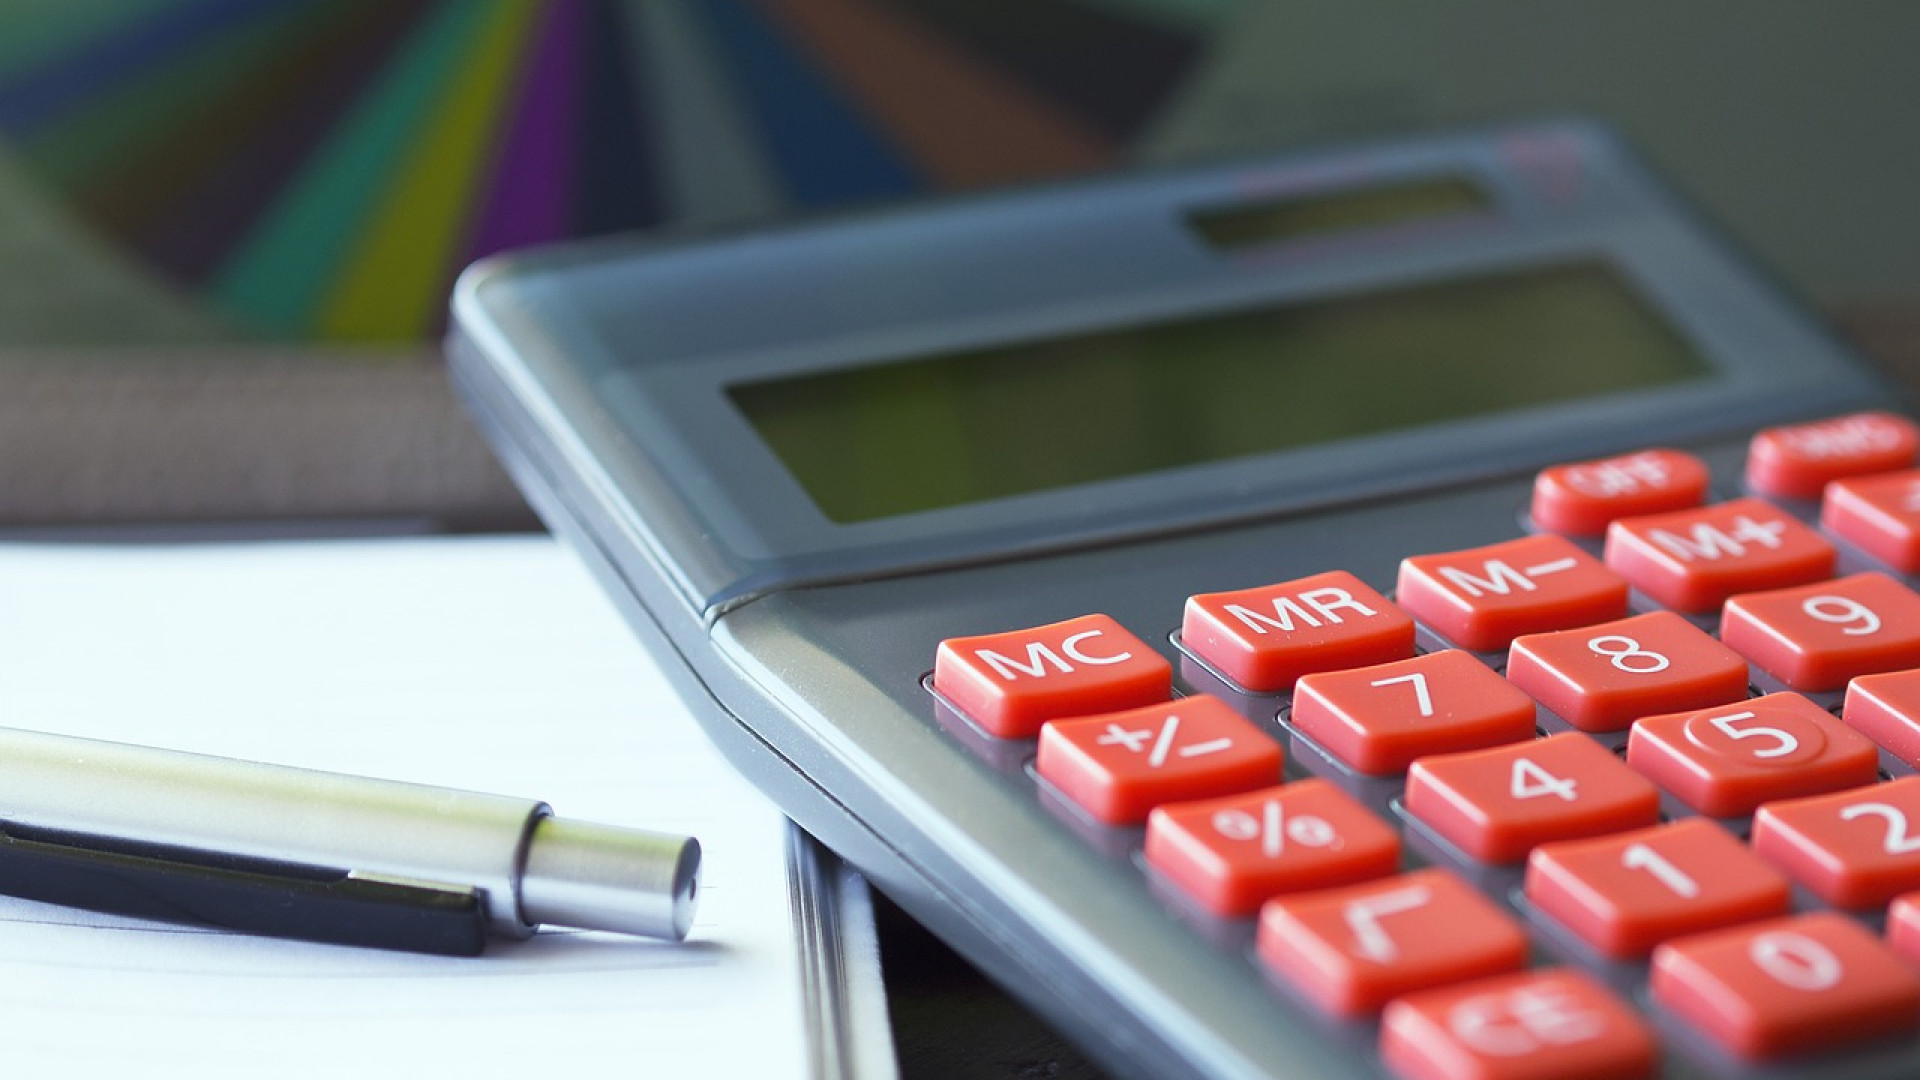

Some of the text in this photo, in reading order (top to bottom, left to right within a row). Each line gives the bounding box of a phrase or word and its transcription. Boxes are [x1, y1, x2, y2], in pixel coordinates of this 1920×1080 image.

[1649, 515, 1785, 561] M+
[1223, 587, 1378, 634] MR
[1802, 595, 1881, 636] 9
[974, 629, 1132, 681] MC
[1587, 635, 1670, 673] 8
[1370, 672, 1434, 717] 7
[1709, 711, 1798, 758] 5
[1511, 758, 1577, 802] 4
[1211, 799, 1338, 858] %
[1840, 802, 1920, 855] 2
[1622, 842, 1698, 898] 1
[1747, 930, 1843, 991] 0
